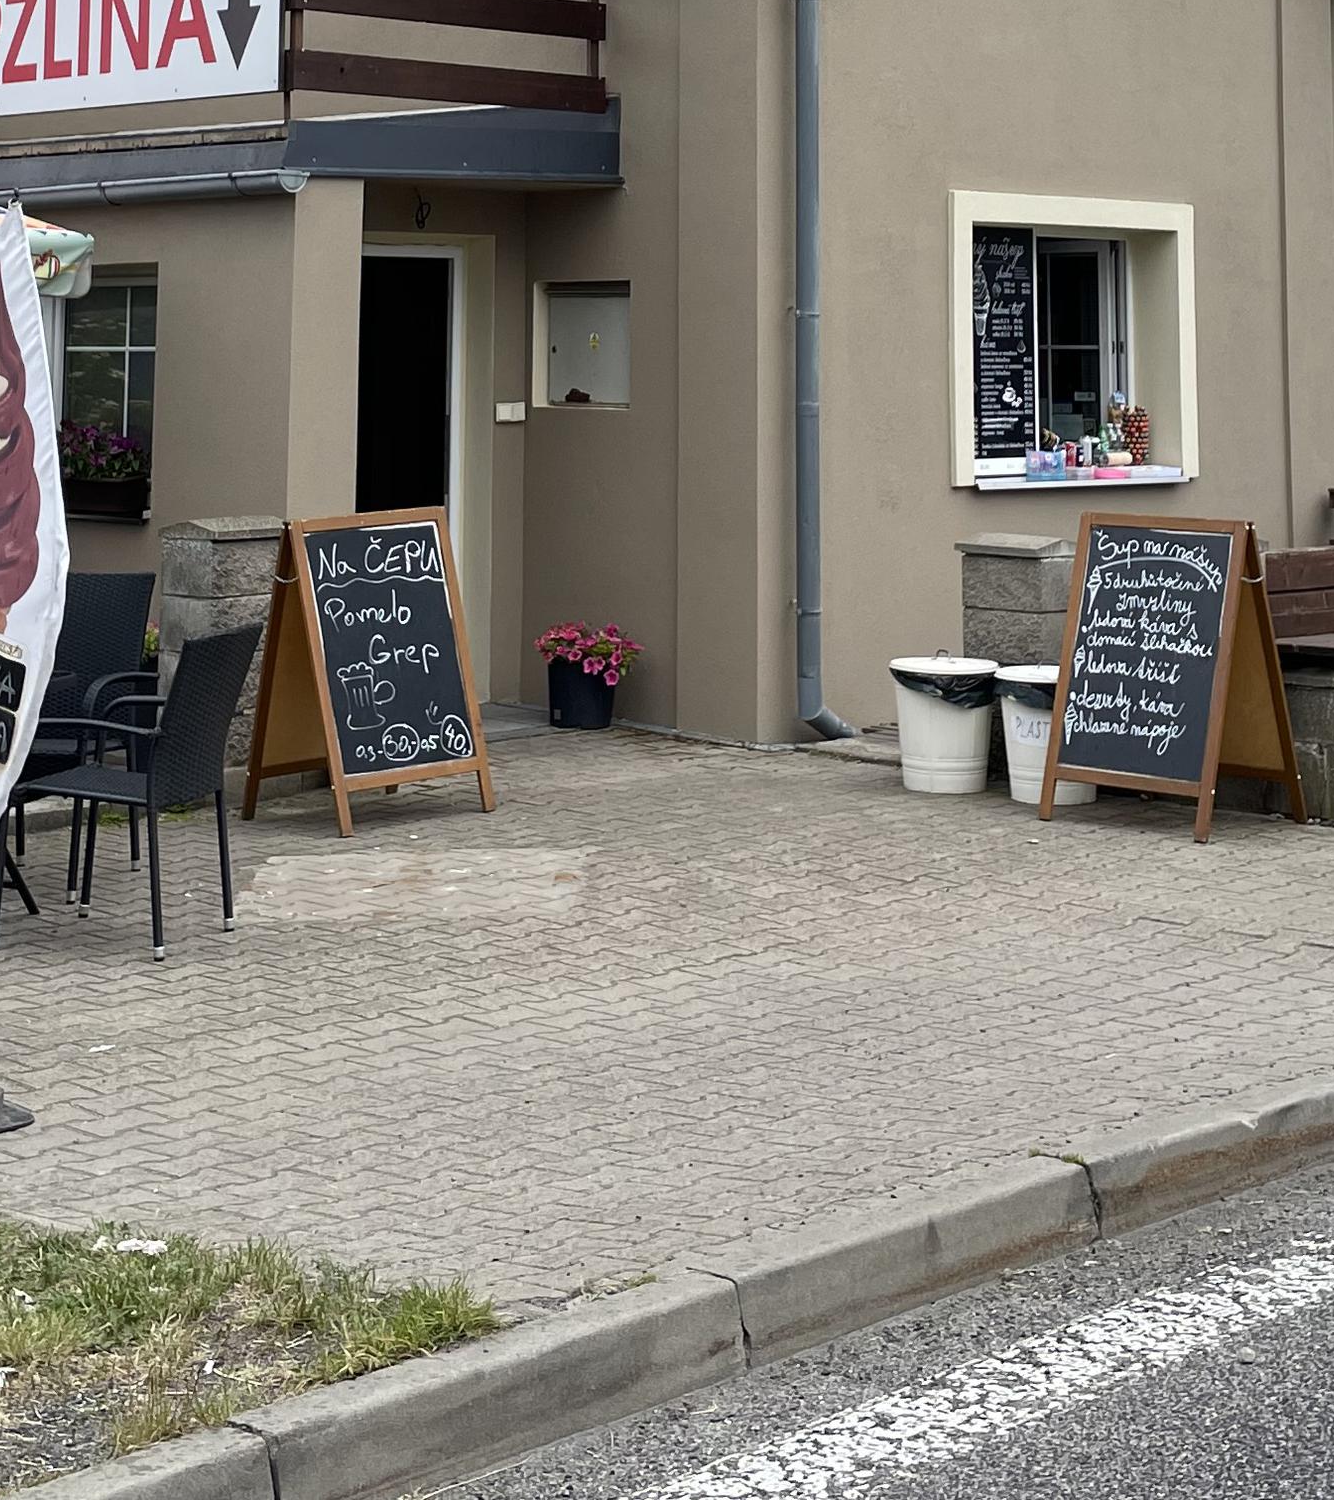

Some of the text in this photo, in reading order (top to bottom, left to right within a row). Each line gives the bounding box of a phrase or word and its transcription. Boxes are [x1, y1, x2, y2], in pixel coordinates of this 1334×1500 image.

[318, 535, 441, 580] Na ČEPU
[1095, 529, 1140, 569] Šup
[1103, 571, 1113, 590] 5
[324, 589, 412, 633] Pomelo
[1087, 608, 1136, 631] ledová
[1138, 609, 1182, 636] káva
[368, 633, 441, 675] Grep
[1139, 688, 1186, 718] káva
